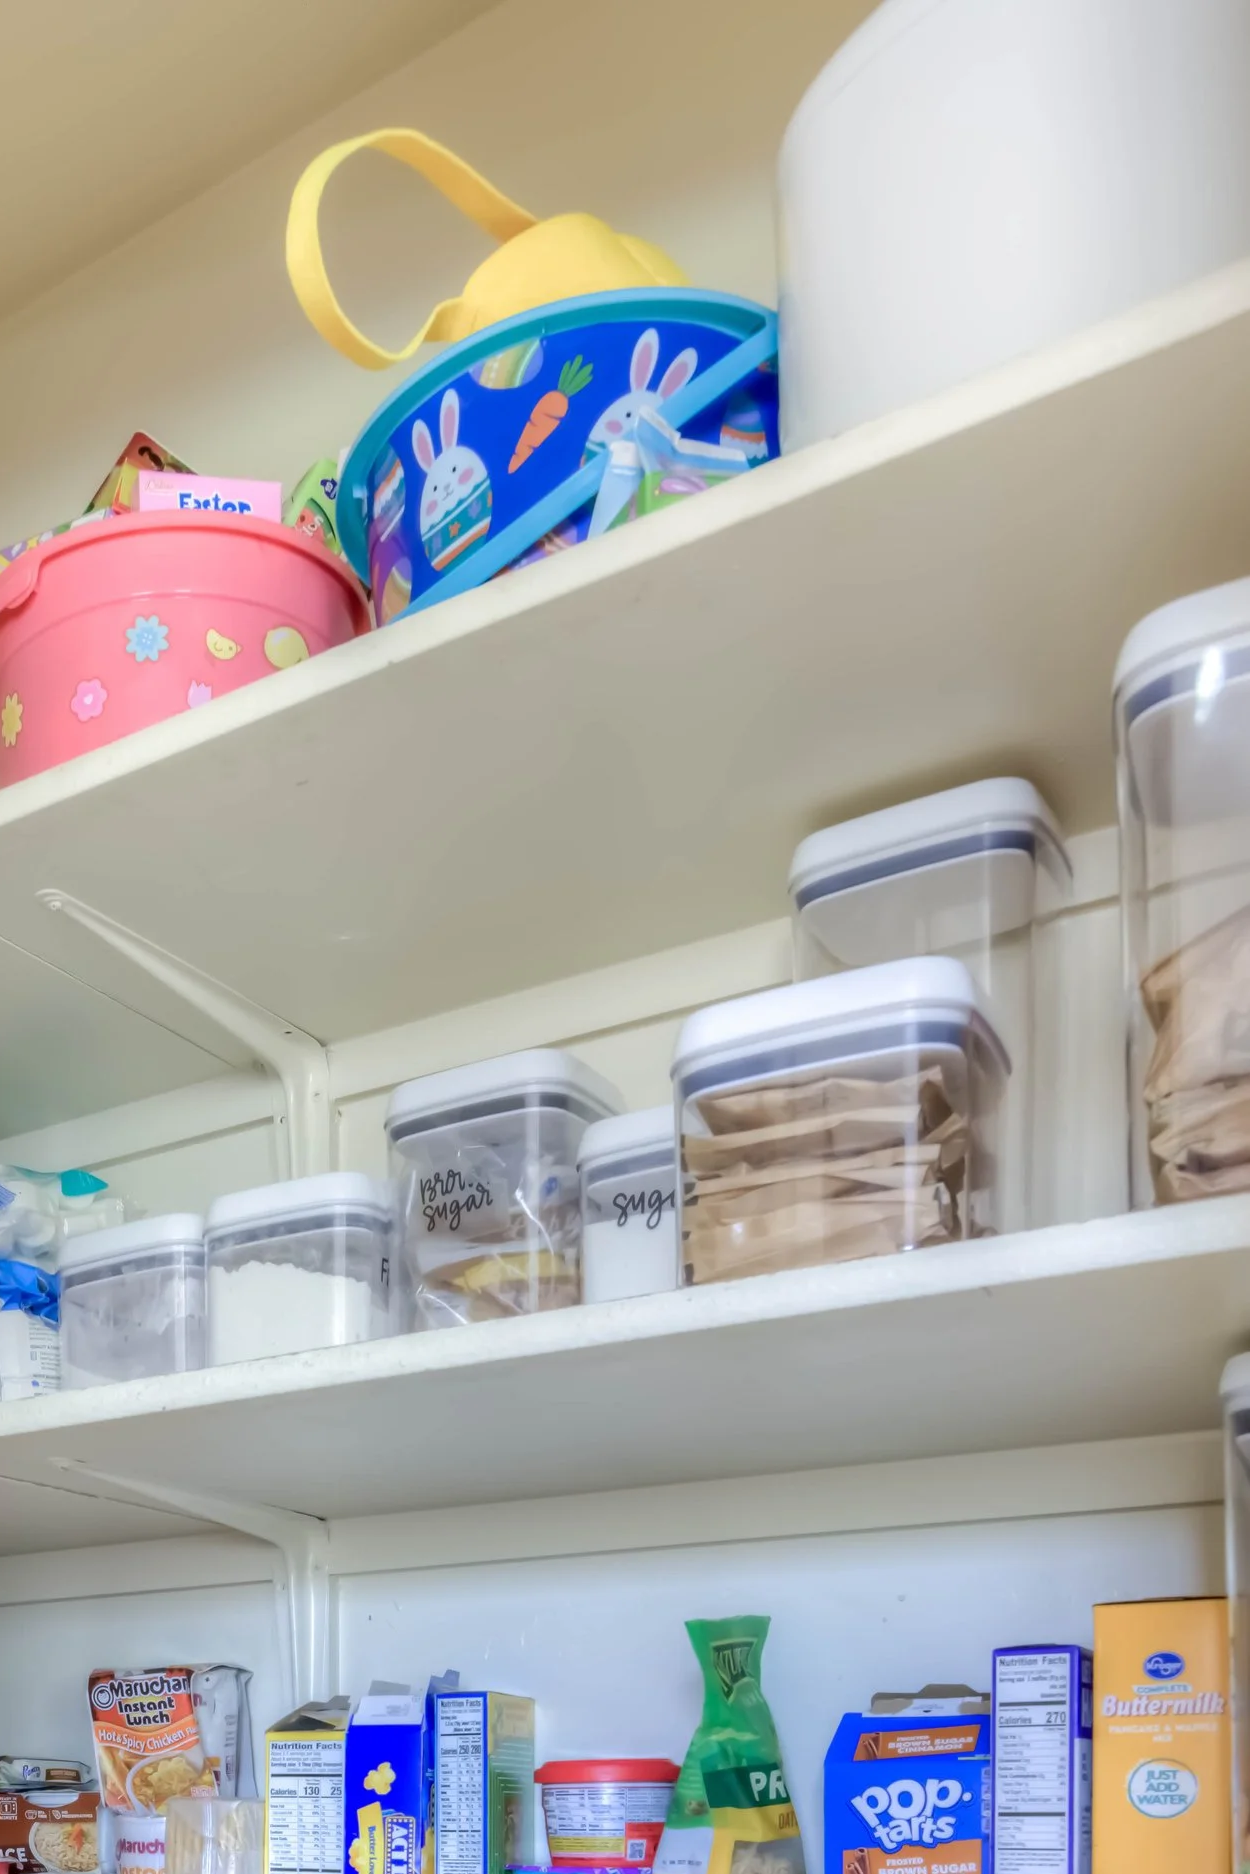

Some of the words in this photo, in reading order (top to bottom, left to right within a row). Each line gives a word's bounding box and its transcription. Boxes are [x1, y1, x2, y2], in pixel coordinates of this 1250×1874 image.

[422, 1182, 494, 1232] sugar
[999, 1656, 1038, 1667] Nutrition
[1042, 1655, 1067, 1665] Facts
[1146, 1657, 1182, 1675] Kroger
[110, 1675, 191, 1698] Maruchan
[117, 1697, 175, 1714] Instant
[440, 1700, 465, 1708] Nutrition
[465, 1700, 481, 1708] Facts
[1102, 1692, 1225, 1717] Buttermilk
[126, 1711, 170, 1726] Lunch
[998, 1716, 1032, 1725] Calories
[1045, 1711, 1066, 1724] 270
[146, 1731, 184, 1750] Chicken
[270, 1742, 313, 1751] Nutrition
[315, 1742, 342, 1750] Facts
[1145, 1769, 1179, 1783] JUST
[270, 1787, 297, 1796] Calories
[303, 1786, 320, 1796] 130
[330, 1786, 342, 1795] 25
[1145, 1782, 1180, 1793] ADD
[1136, 1794, 1188, 1805] WATER
[873, 1815, 957, 1850] tarts
[119, 1838, 165, 1854] Maruch
[367, 1825, 378, 1856] Butter
[391, 1824, 408, 1863] ACT
[886, 1857, 924, 1866] FROSTED
[931, 1863, 977, 1874] SUGAR
